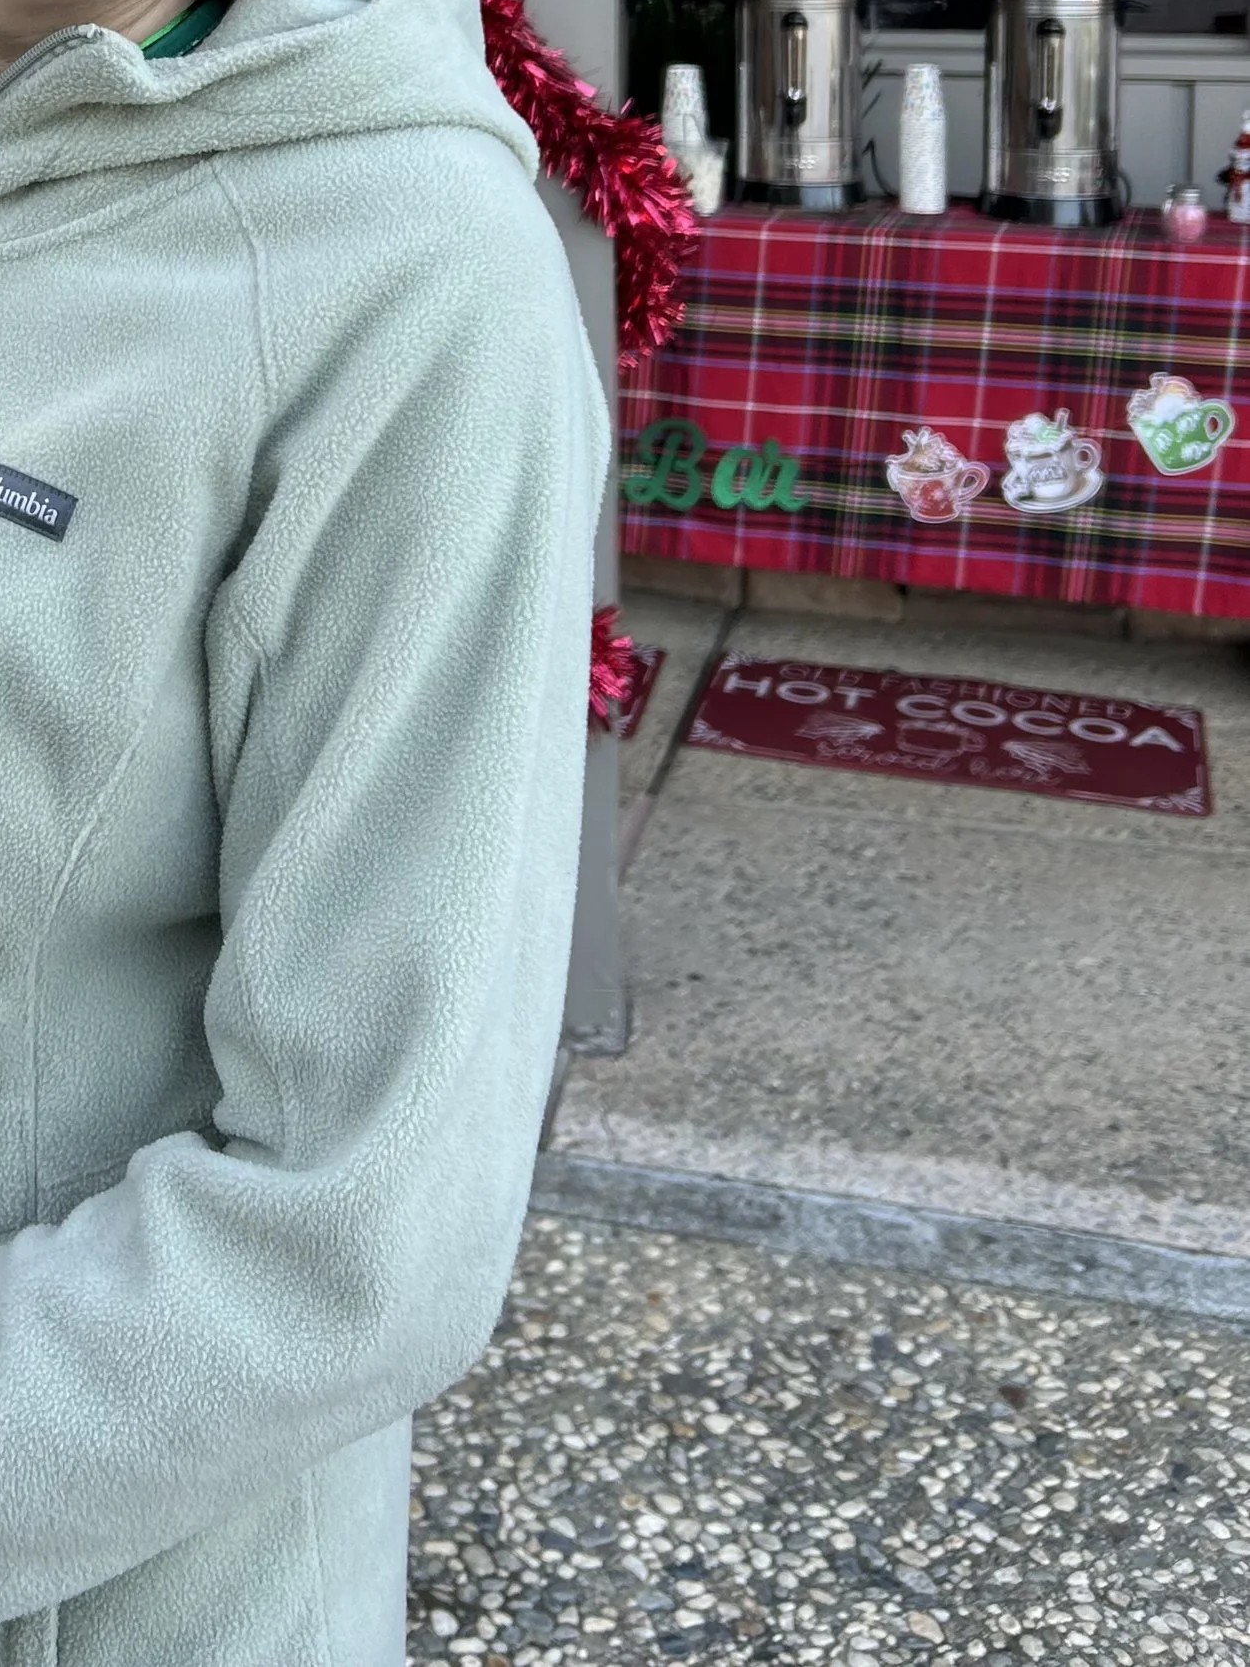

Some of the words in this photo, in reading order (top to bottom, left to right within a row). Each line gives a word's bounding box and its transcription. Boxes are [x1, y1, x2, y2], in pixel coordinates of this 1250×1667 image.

[624, 417, 812, 512] Bar
[722, 671, 878, 710] HOT
[895, 693, 1186, 753] COCOA
[779, 662, 864, 686] OLD
[880, 674, 1134, 720] FASHIONED
